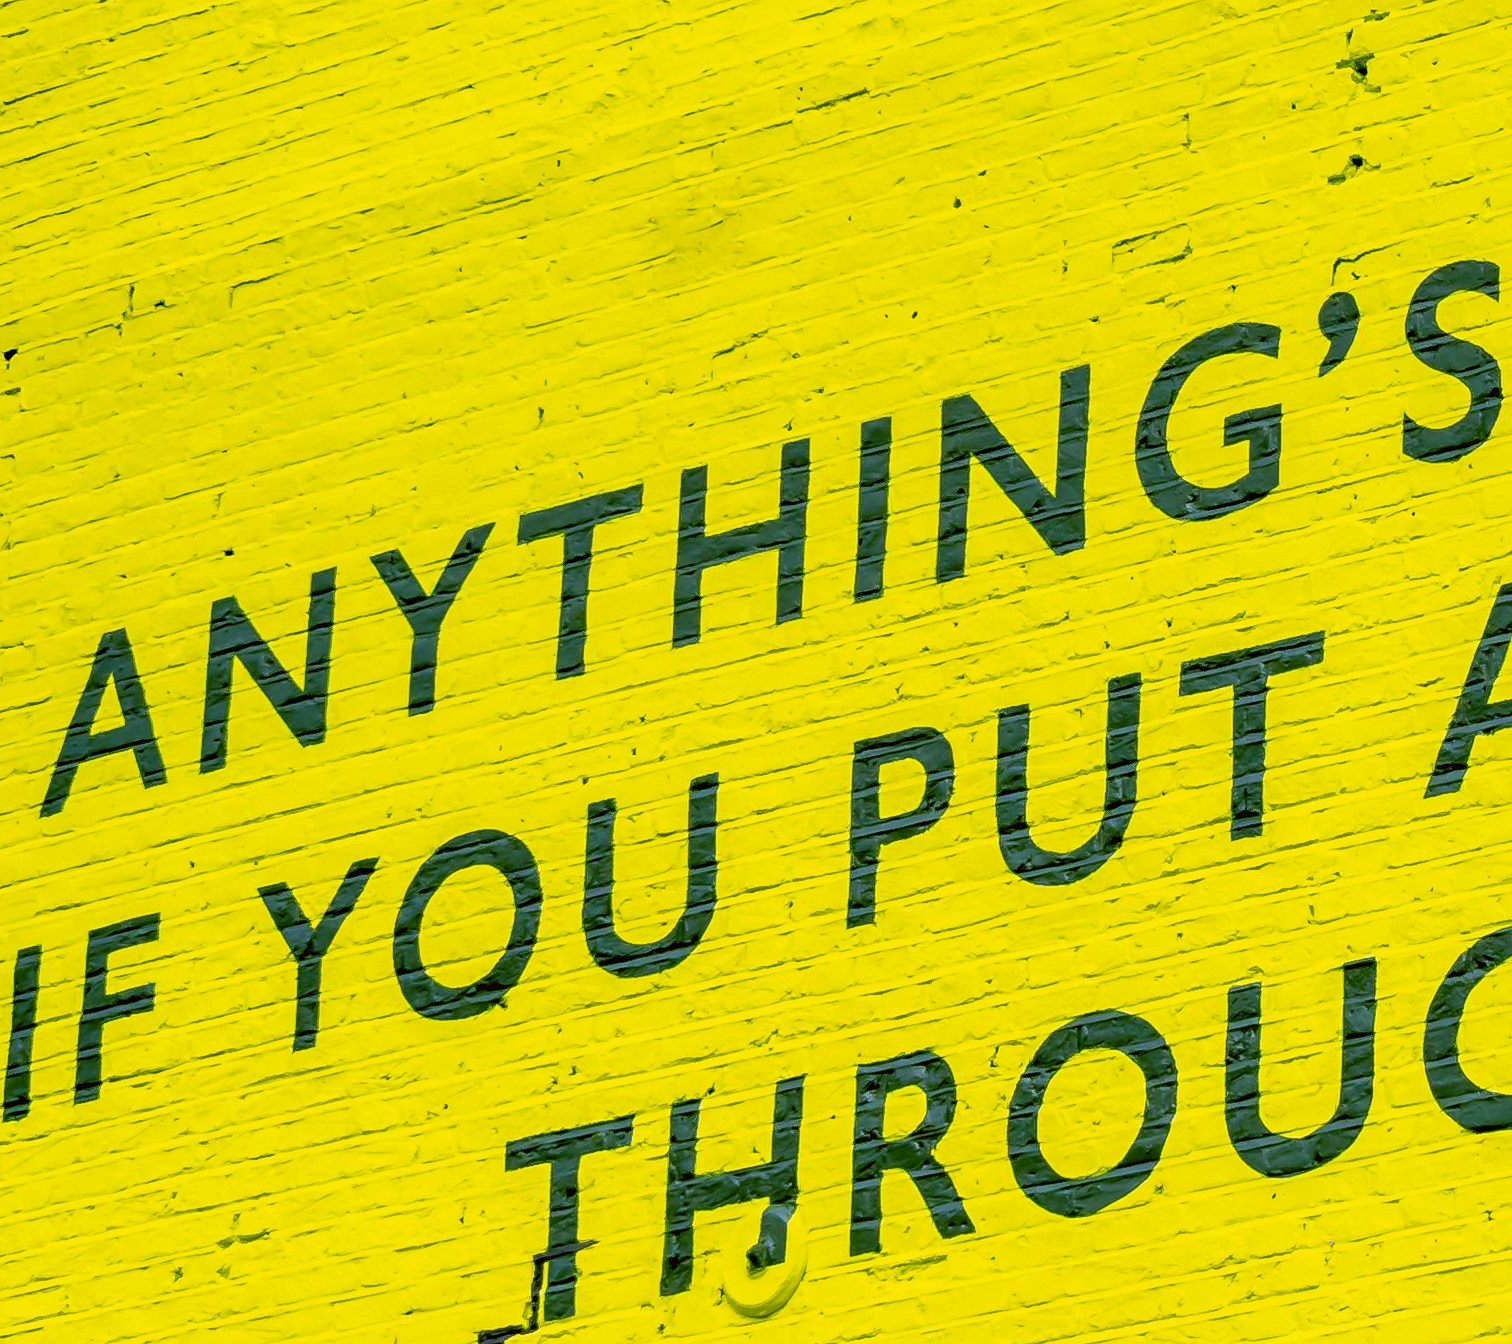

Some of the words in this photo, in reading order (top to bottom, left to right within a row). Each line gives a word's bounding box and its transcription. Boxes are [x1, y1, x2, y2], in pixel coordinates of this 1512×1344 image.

[0, 913, 163, 1123] IF
[257, 772, 720, 1053] YOU
[846, 631, 1325, 929] PUT
